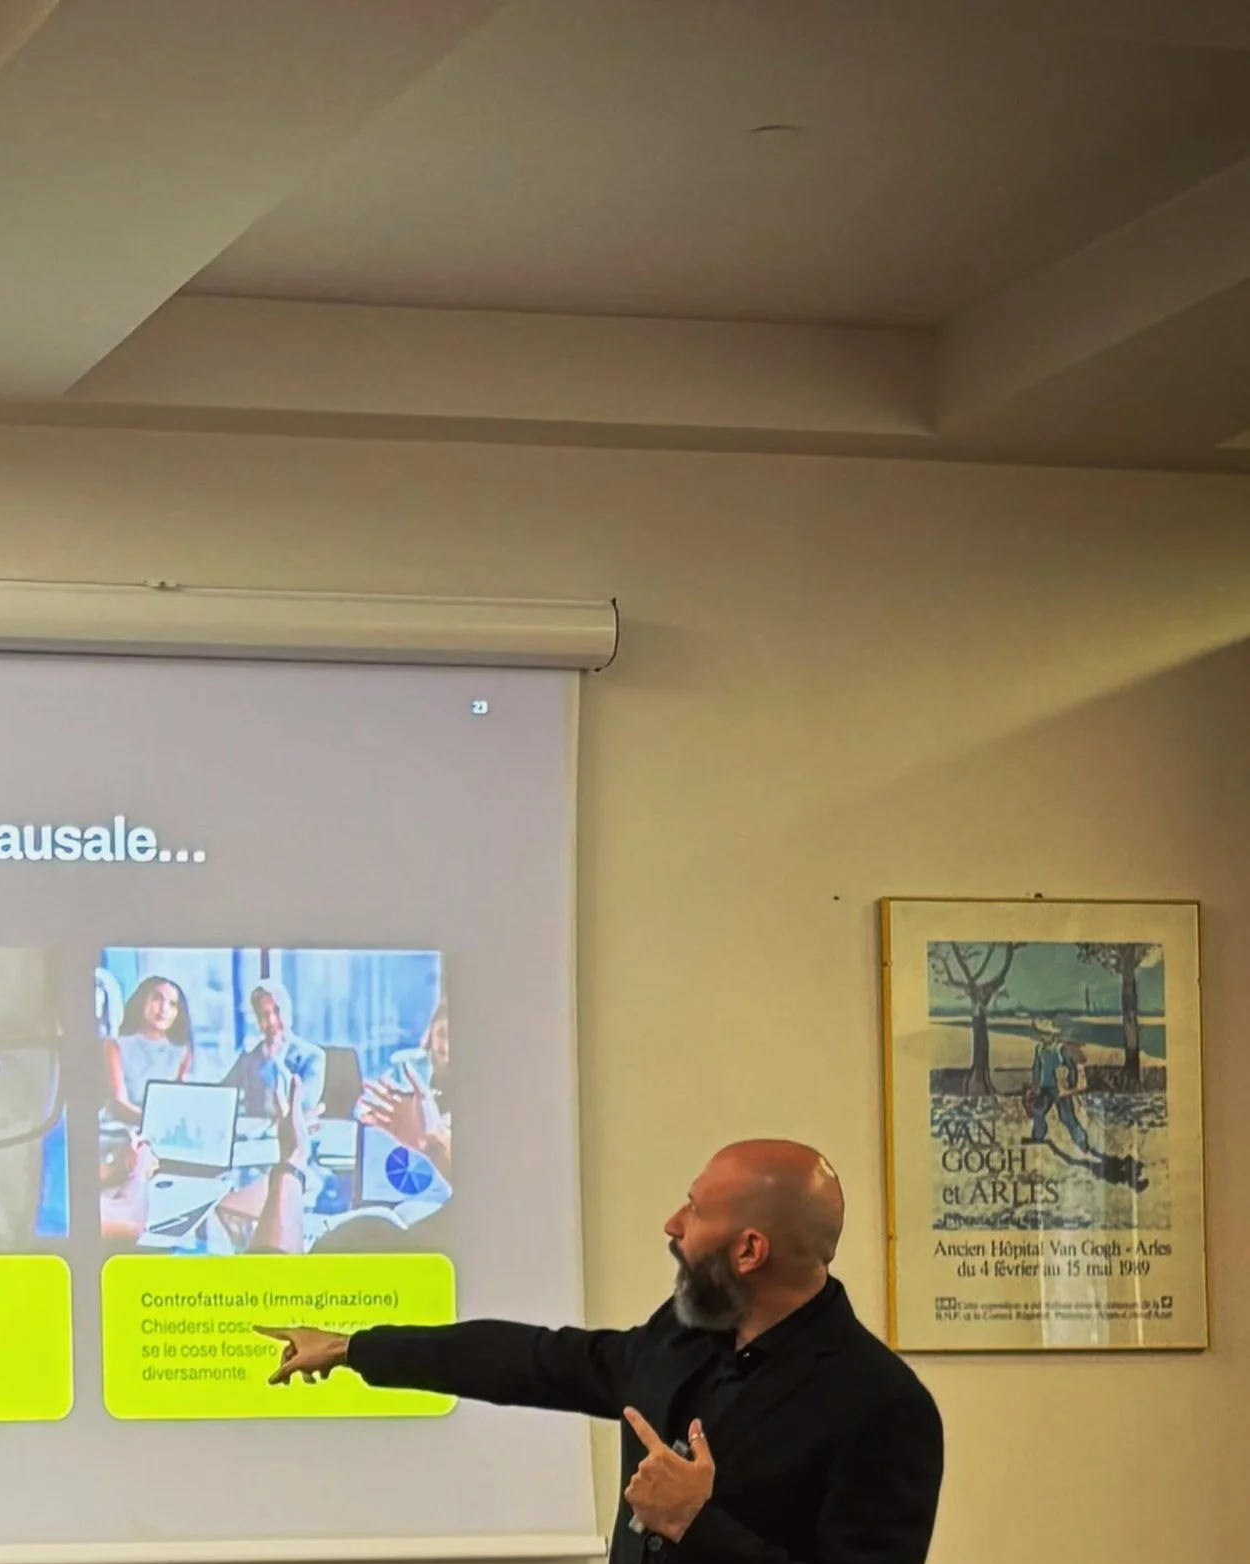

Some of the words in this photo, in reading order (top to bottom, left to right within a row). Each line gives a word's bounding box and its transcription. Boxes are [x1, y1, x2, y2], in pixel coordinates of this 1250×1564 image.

[939, 1120, 996, 1147] VAN
[941, 1148, 1027, 1173] GOGH
[942, 1185, 961, 1205] et
[969, 1180, 1059, 1206] ARLES
[933, 1241, 985, 1257] Ancien
[991, 1240, 1044, 1260] Hôpital
[1050, 1242, 1077, 1257] Van
[1081, 1240, 1121, 1260] Gogh
[1136, 1240, 1172, 1257] Arles
[957, 1261, 975, 1277] du
[981, 1261, 989, 1276] 4
[994, 1260, 1039, 1277] février
[1043, 1263, 1061, 1277] au
[1067, 1260, 1081, 1276] 15
[1086, 1260, 1113, 1276] mai
[141, 1291, 259, 1308] Controfattuale
[262, 1292, 399, 1310] (Immaginazione)
[141, 1318, 214, 1335] Chiedersi
[142, 1344, 160, 1358] se
[163, 1342, 177, 1358] le
[180, 1344, 217, 1358] cose
[221, 1340, 277, 1358] fossero
